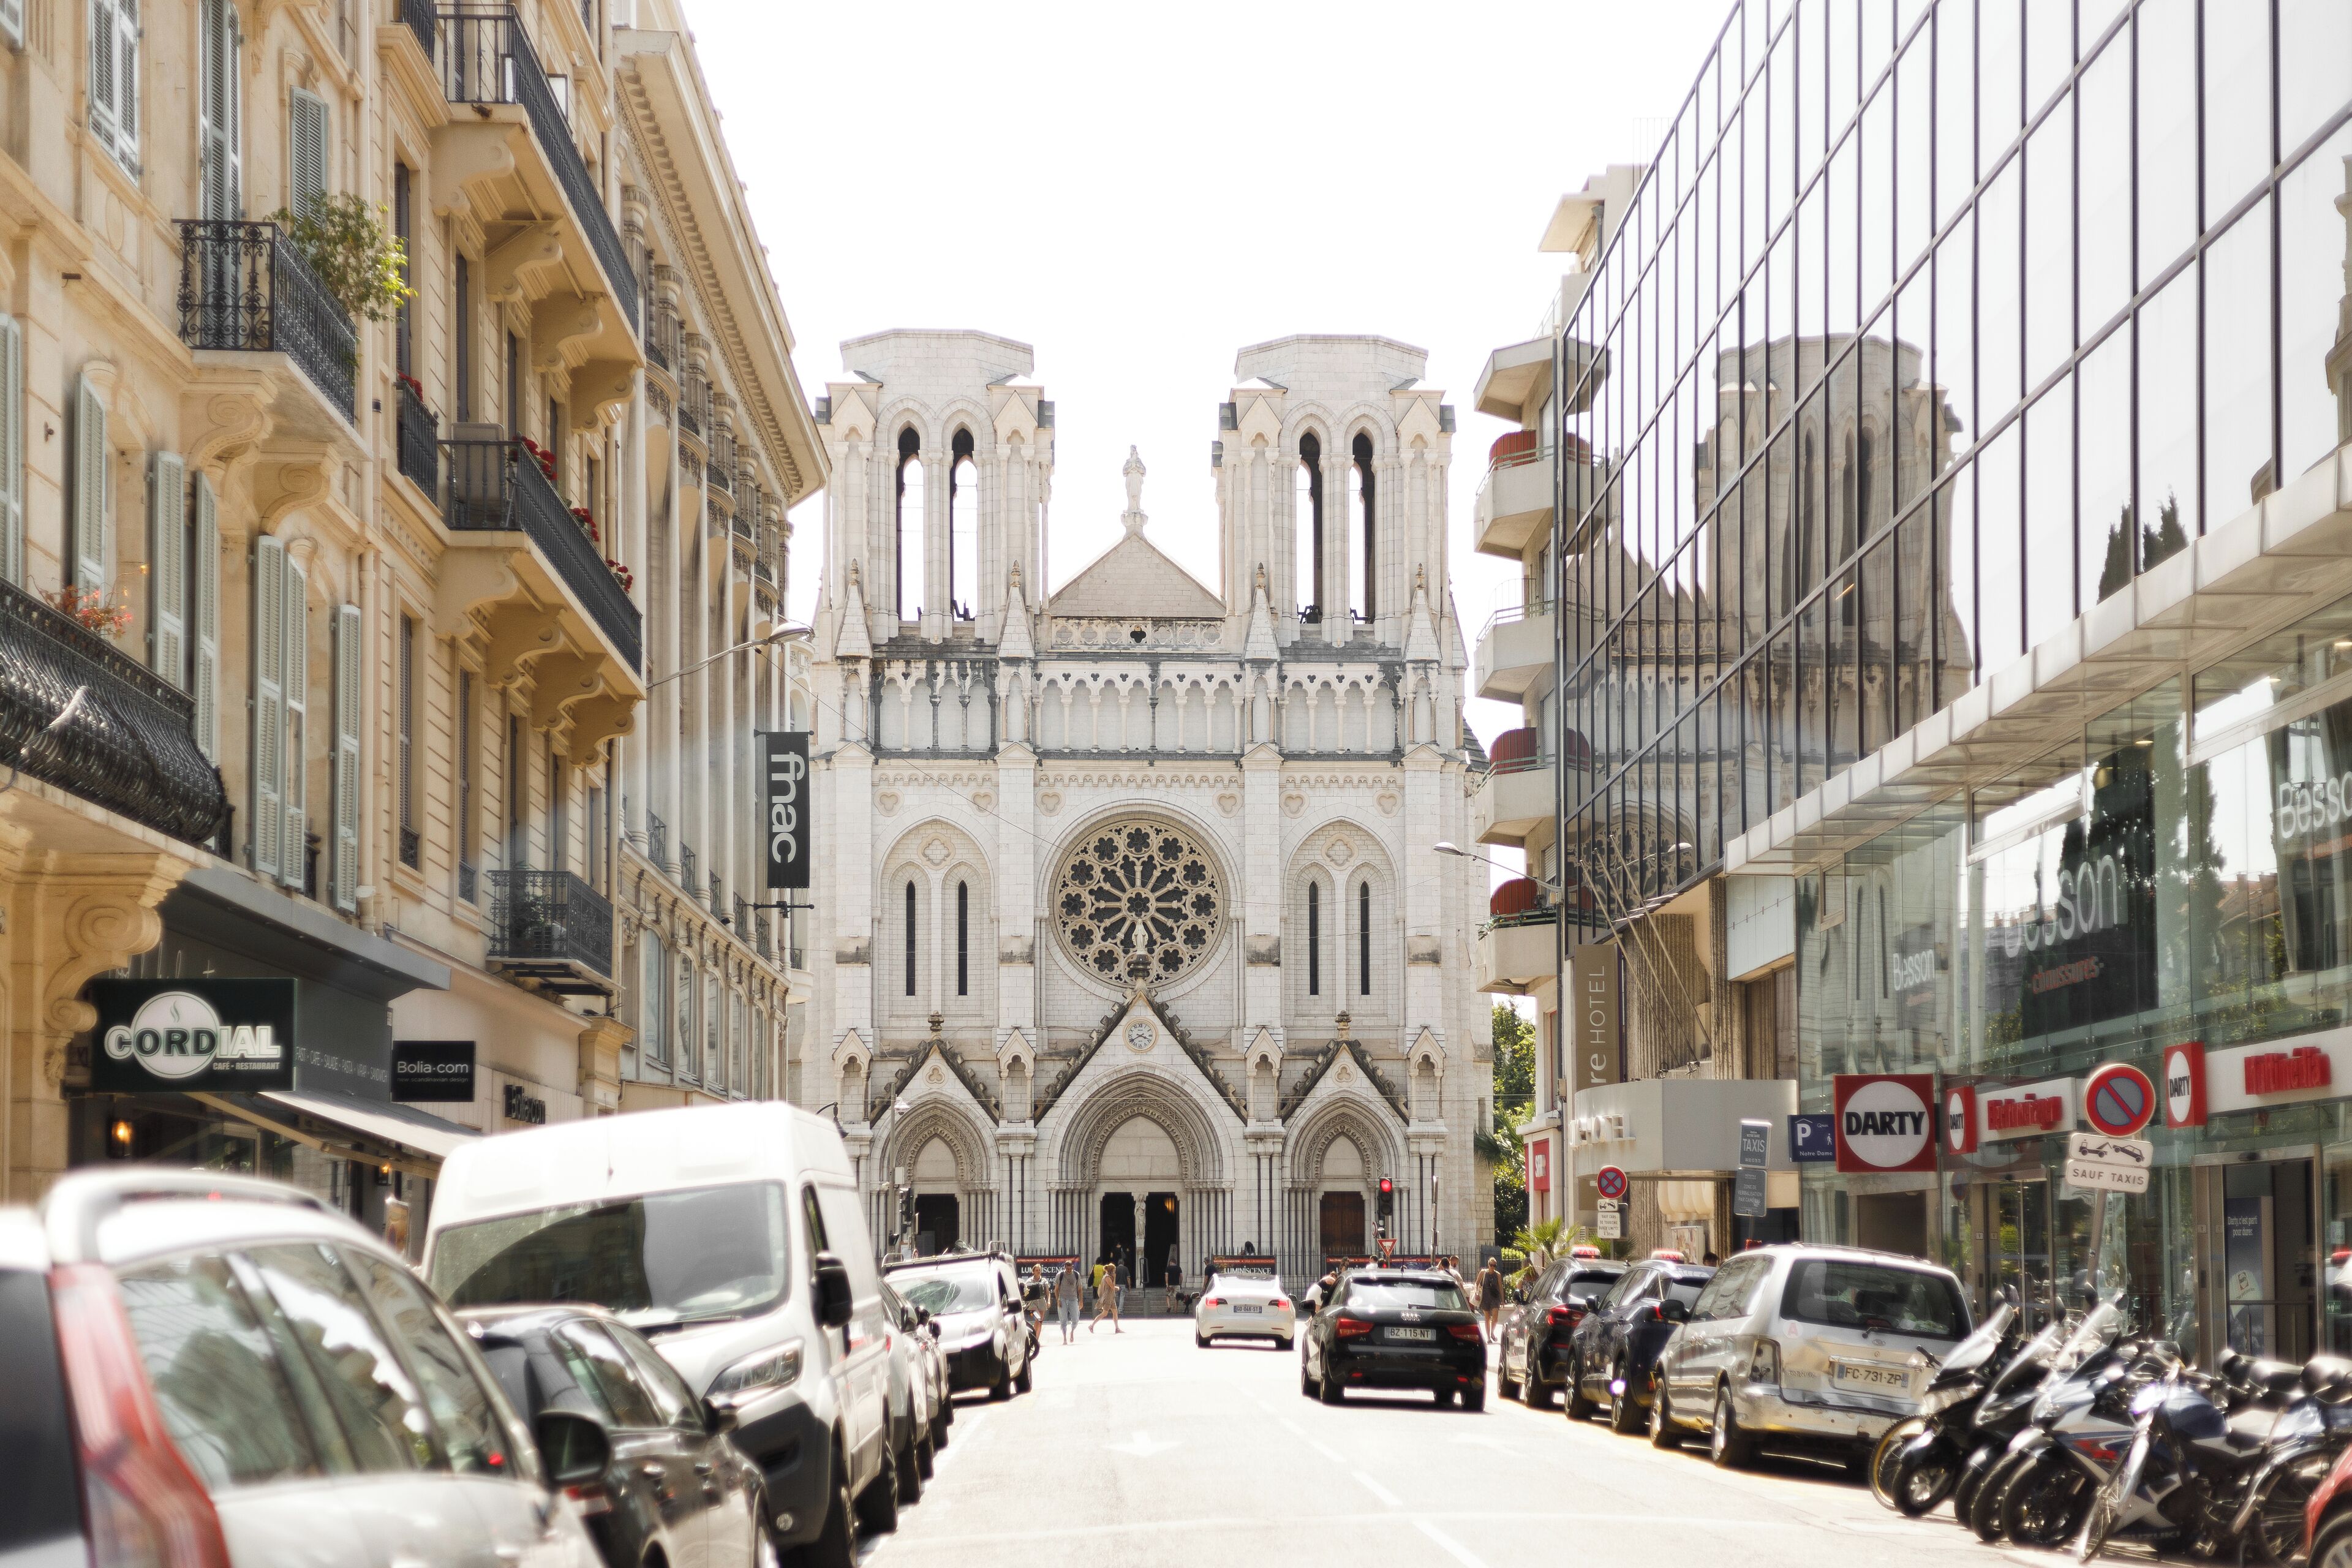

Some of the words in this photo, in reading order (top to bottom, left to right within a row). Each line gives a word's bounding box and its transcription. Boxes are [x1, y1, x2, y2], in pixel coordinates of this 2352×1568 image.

[771, 752, 805, 864] fnac
[2280, 771, 2352, 839] Besso
[1893, 949, 1935, 990] Besson
[1589, 965, 1605, 1044] HOTEL
[104, 1025, 281, 1060] CORDIAL
[213, 1061, 230, 1070] CAFÉ
[2169, 1076, 2190, 1098] DARTY
[1845, 1112, 1925, 1135] DARTY
[1950, 1113, 1964, 1130] DARTY
[1743, 1139, 1765, 1152] TAXIS
[2073, 1169, 2104, 1180] SAUF
[2111, 1173, 2144, 1185] TAXIS
